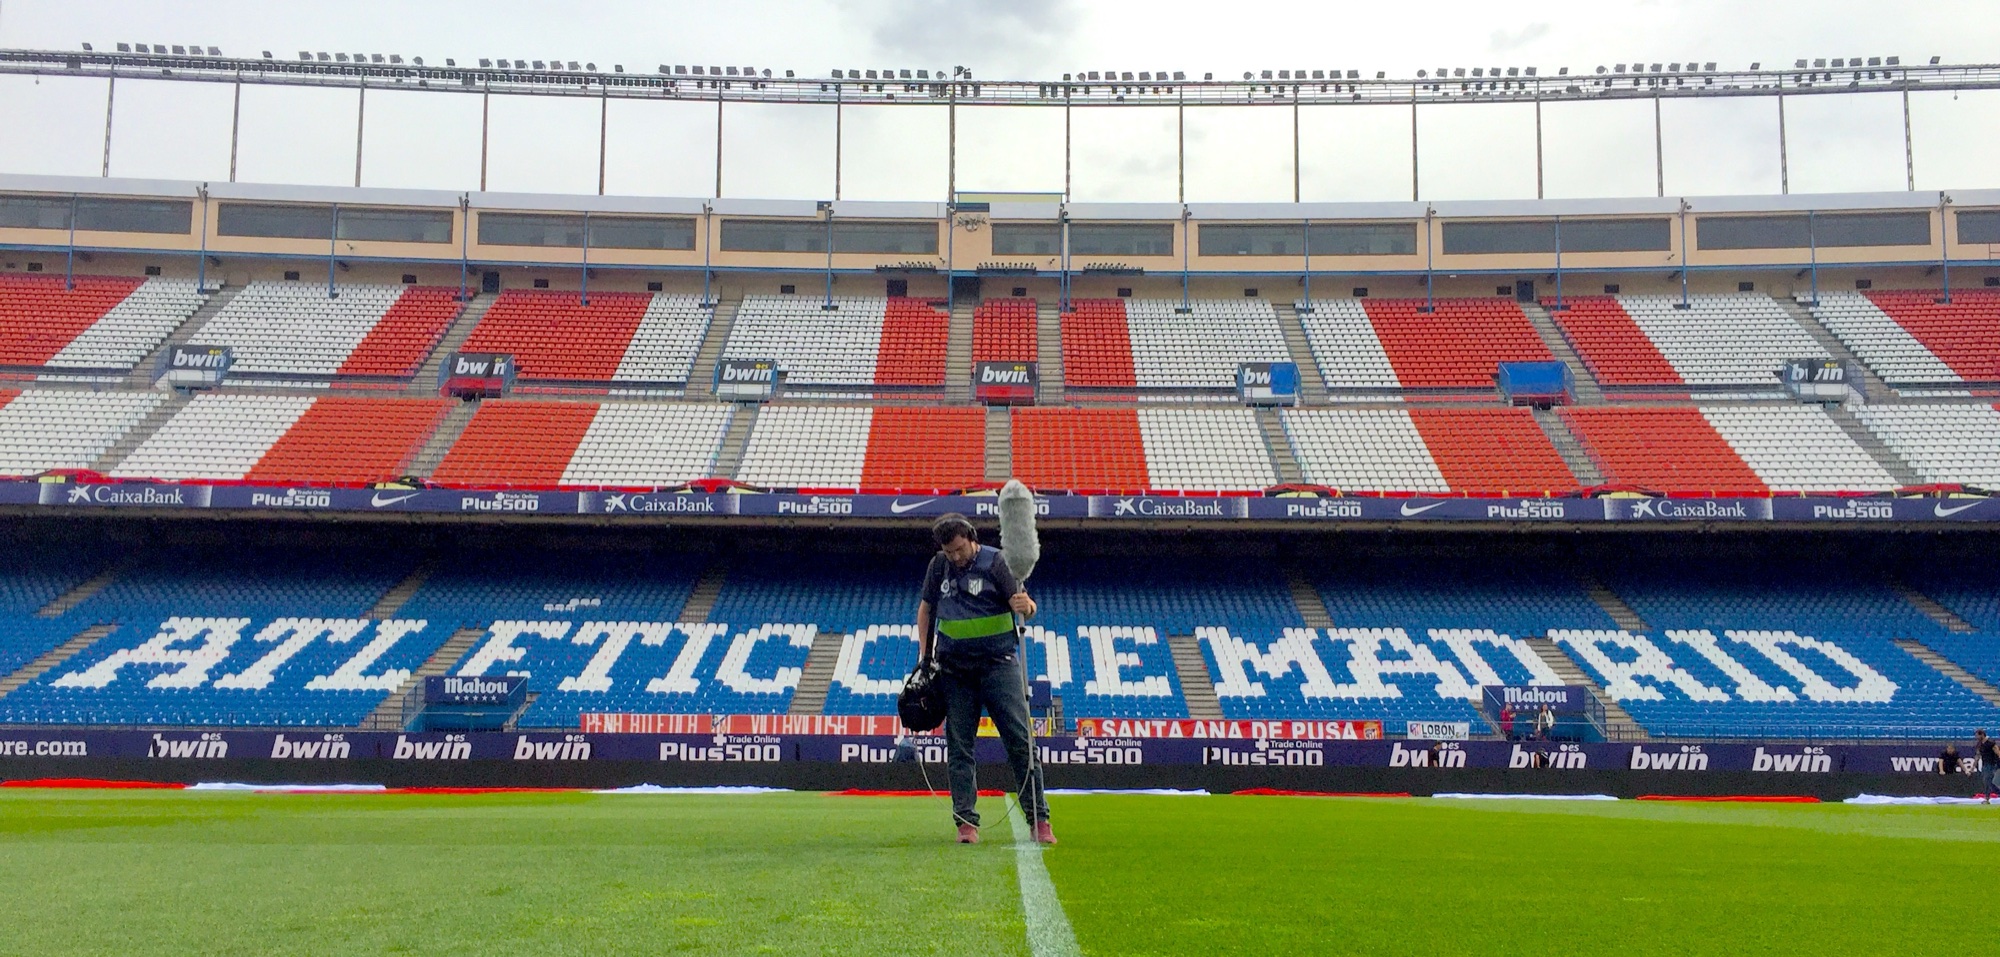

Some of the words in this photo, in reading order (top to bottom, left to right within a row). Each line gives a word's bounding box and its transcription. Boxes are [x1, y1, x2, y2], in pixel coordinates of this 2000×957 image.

[173, 349, 226, 367] bwin
[723, 364, 771, 380] bwin
[1244, 368, 1271, 384] bw
[95, 487, 184, 504] CaixaBank
[252, 493, 330, 506] Plus500
[462, 497, 539, 511] Plus500
[630, 497, 714, 512] CaixaBank
[778, 501, 852, 514] Plus500
[1139, 499, 1223, 516] CaixaBank
[1288, 503, 1362, 517] Plus500
[1488, 505, 1564, 518] Plus500
[1657, 502, 1746, 518] CaixaBank
[1814, 505, 1893, 519] Plus500
[1196, 626, 1896, 704] MADRID
[444, 677, 508, 694] Mahou
[1503, 686, 1568, 703] Mahou
[1102, 720, 1184, 738] SANTA
[1193, 721, 1243, 738] ANA
[1252, 722, 1282, 739] DE
[1292, 722, 1357, 739] PUSA
[1422, 722, 1455, 735] LOBÓN
[210, 733, 221, 741] es
[729, 736, 752, 744] Trade
[754, 736, 780, 744] Online
[1089, 739, 1112, 747] Trade
[1114, 739, 1142, 747] Online
[1271, 741, 1294, 749] Trade
[1295, 741, 1323, 749] Online
[148, 733, 228, 758] bwin
[271, 734, 350, 758] bwin
[393, 735, 472, 760] bwin
[514, 735, 591, 760] bwin
[660, 743, 780, 761] Plus500
[1569, 744, 1580, 752] es
[1036, 746, 1142, 764] lus500
[1203, 747, 1323, 765] Plus500
[1630, 746, 1708, 770] bwin
[1752, 747, 1831, 772] bwin
